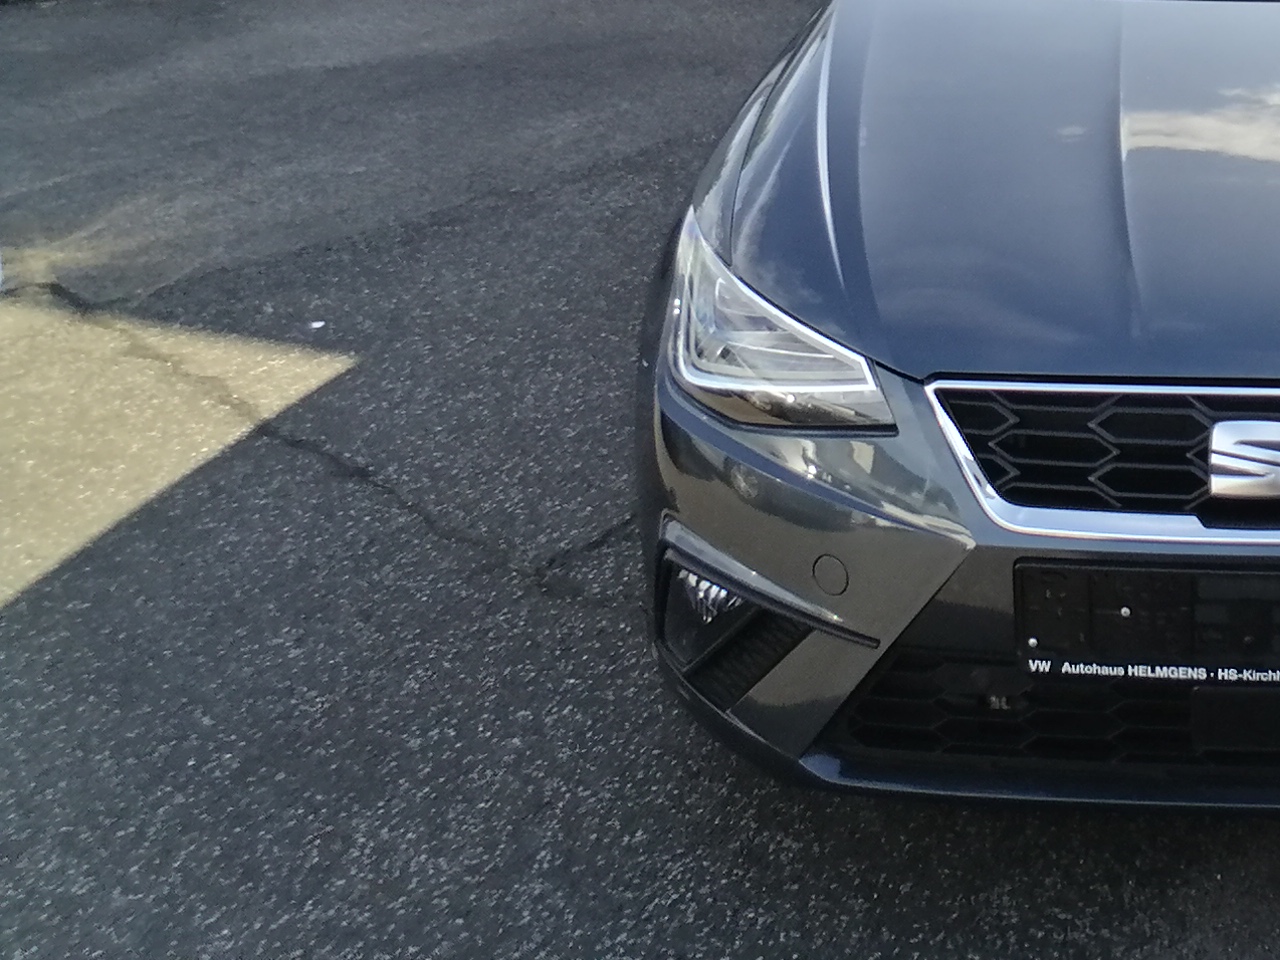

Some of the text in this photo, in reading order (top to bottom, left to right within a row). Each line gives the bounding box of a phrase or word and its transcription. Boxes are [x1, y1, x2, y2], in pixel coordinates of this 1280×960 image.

[1028, 659, 1051, 673] VW
[1061, 661, 1125, 676] Autohaus
[1127, 664, 1207, 680] HELMGENS
